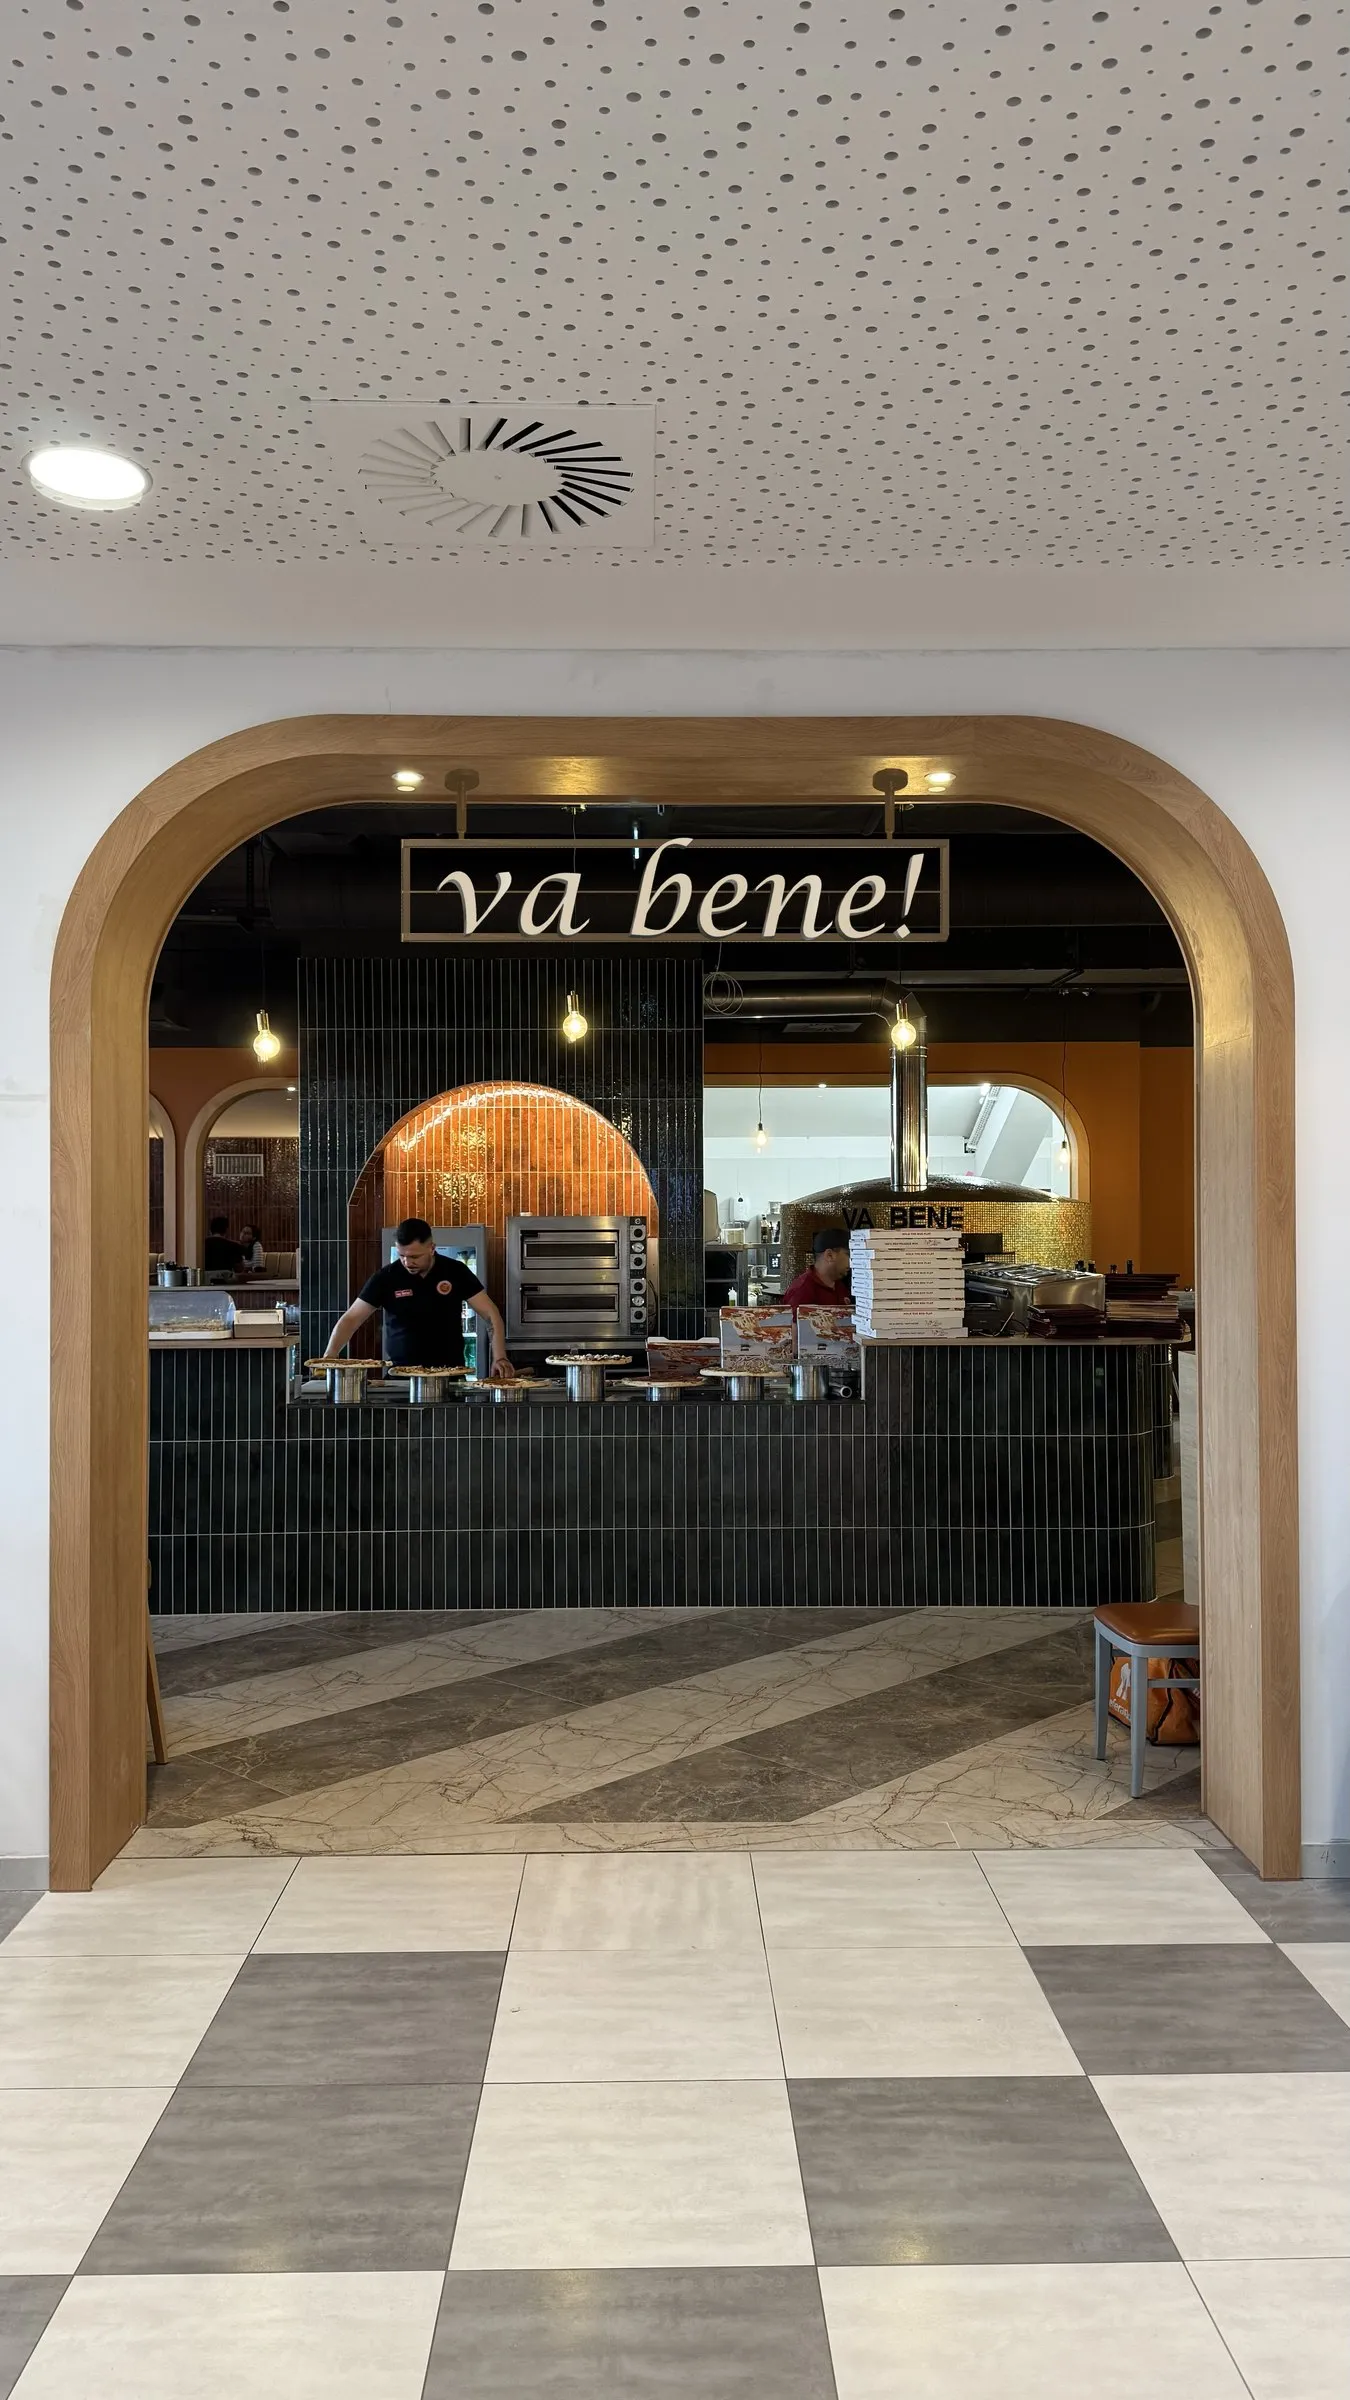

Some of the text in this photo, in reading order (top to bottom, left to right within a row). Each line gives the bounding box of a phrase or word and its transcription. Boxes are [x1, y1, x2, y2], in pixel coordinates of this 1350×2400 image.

[437, 837, 926, 940] va bene!
[842, 1207, 964, 1231] VA BENE
